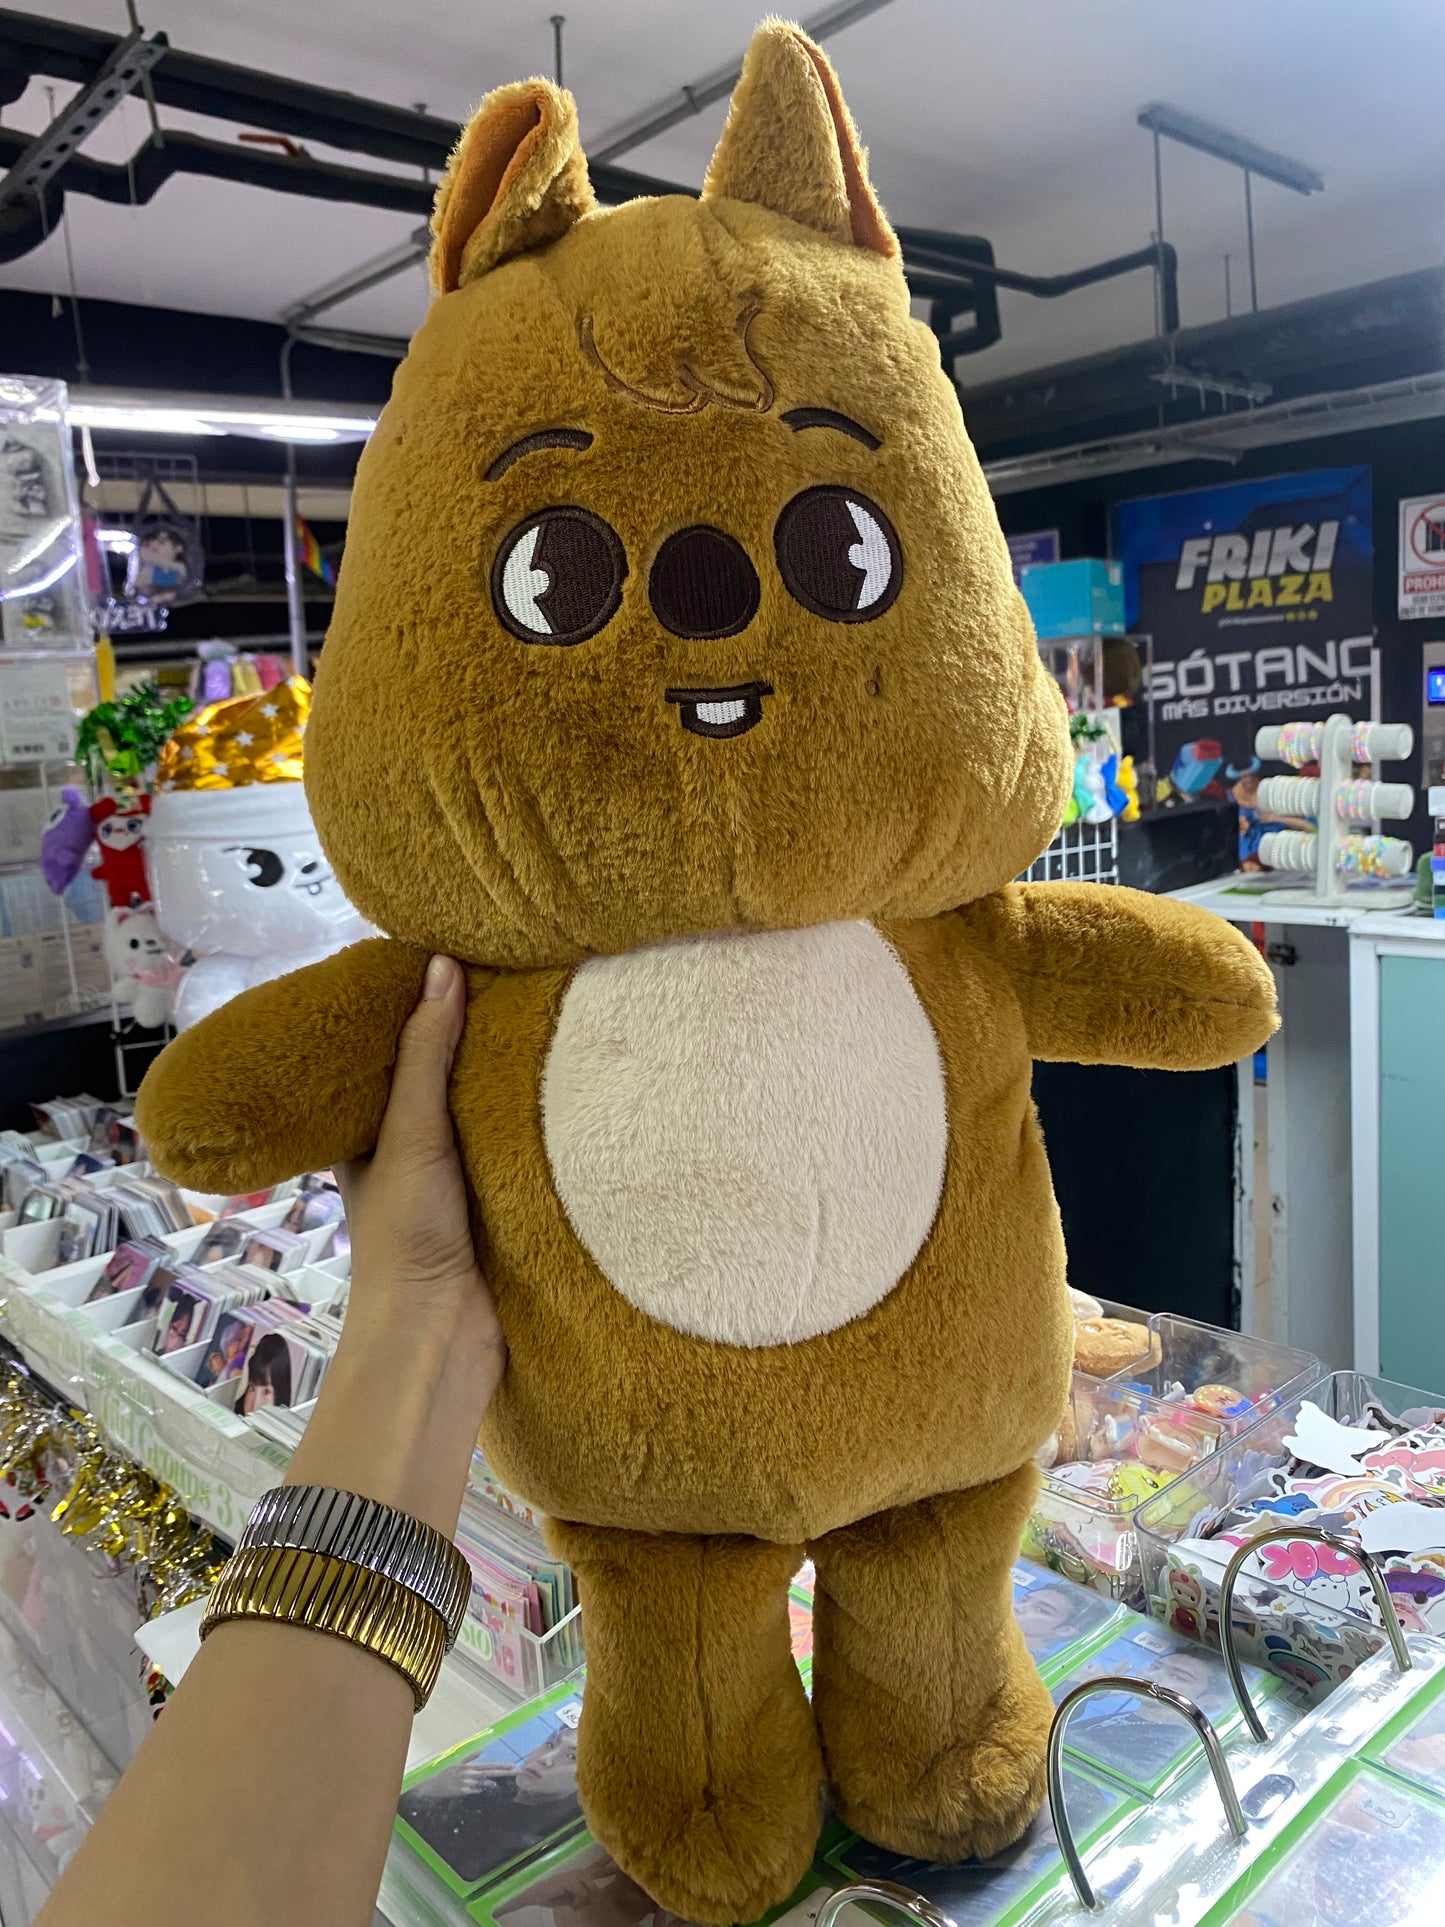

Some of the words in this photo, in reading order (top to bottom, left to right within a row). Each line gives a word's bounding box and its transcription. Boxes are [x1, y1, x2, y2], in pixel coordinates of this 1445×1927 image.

[1175, 520, 1339, 590] FRIKI
[1201, 571, 1333, 614] PLAZA
[1162, 696, 1208, 721] MÁS
[1213, 679, 1362, 717] DIVERSIÓN
[217, 1483, 233, 1528] 3
